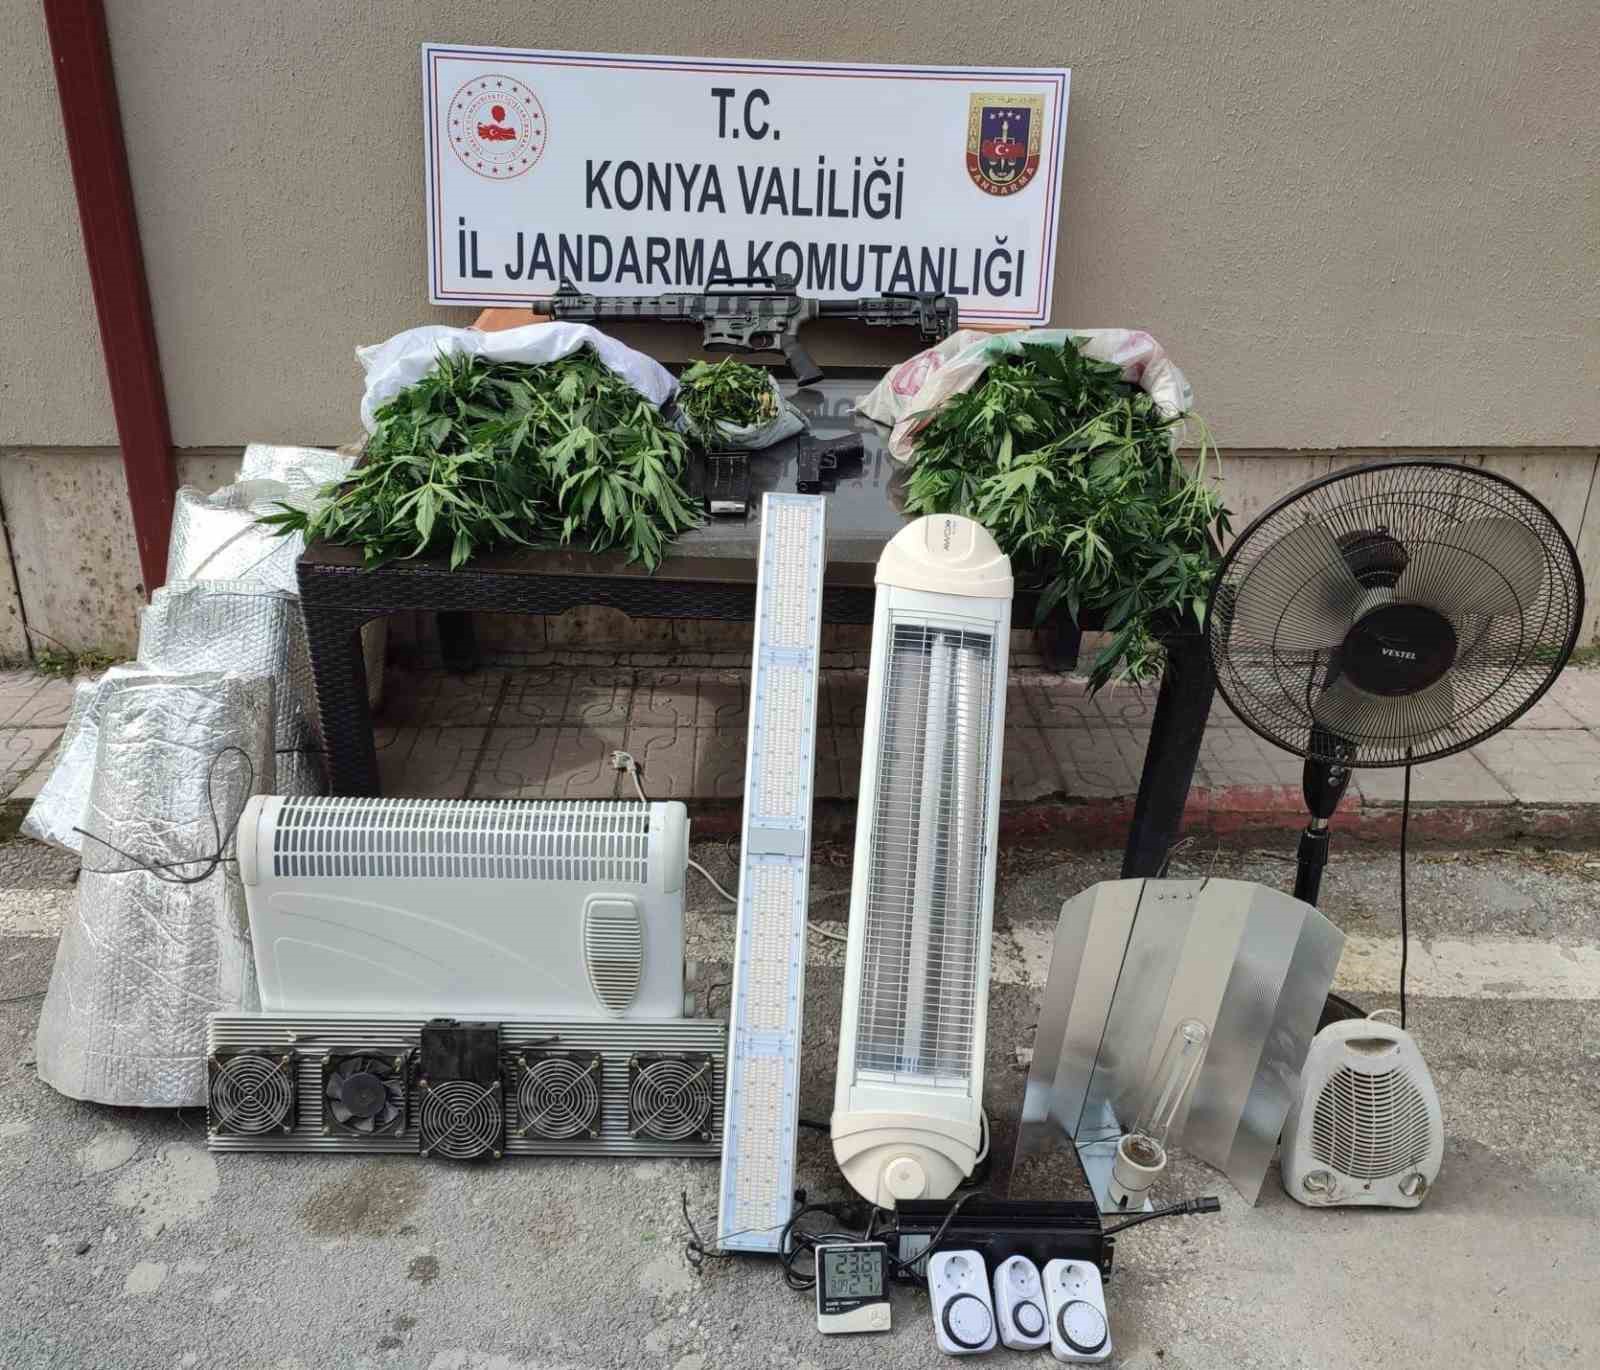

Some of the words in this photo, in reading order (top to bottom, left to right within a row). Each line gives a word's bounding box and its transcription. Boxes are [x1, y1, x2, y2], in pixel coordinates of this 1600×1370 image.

[711, 87, 780, 141] T.C.
[585, 159, 726, 214] KONYA
[737, 155, 905, 220] VALİLİĞİ
[969, 166, 1035, 195] JANDARMA
[458, 216, 493, 279] İL
[505, 231, 733, 286] JANDARMA
[747, 235, 1026, 297] KOMUTANLIĞI
